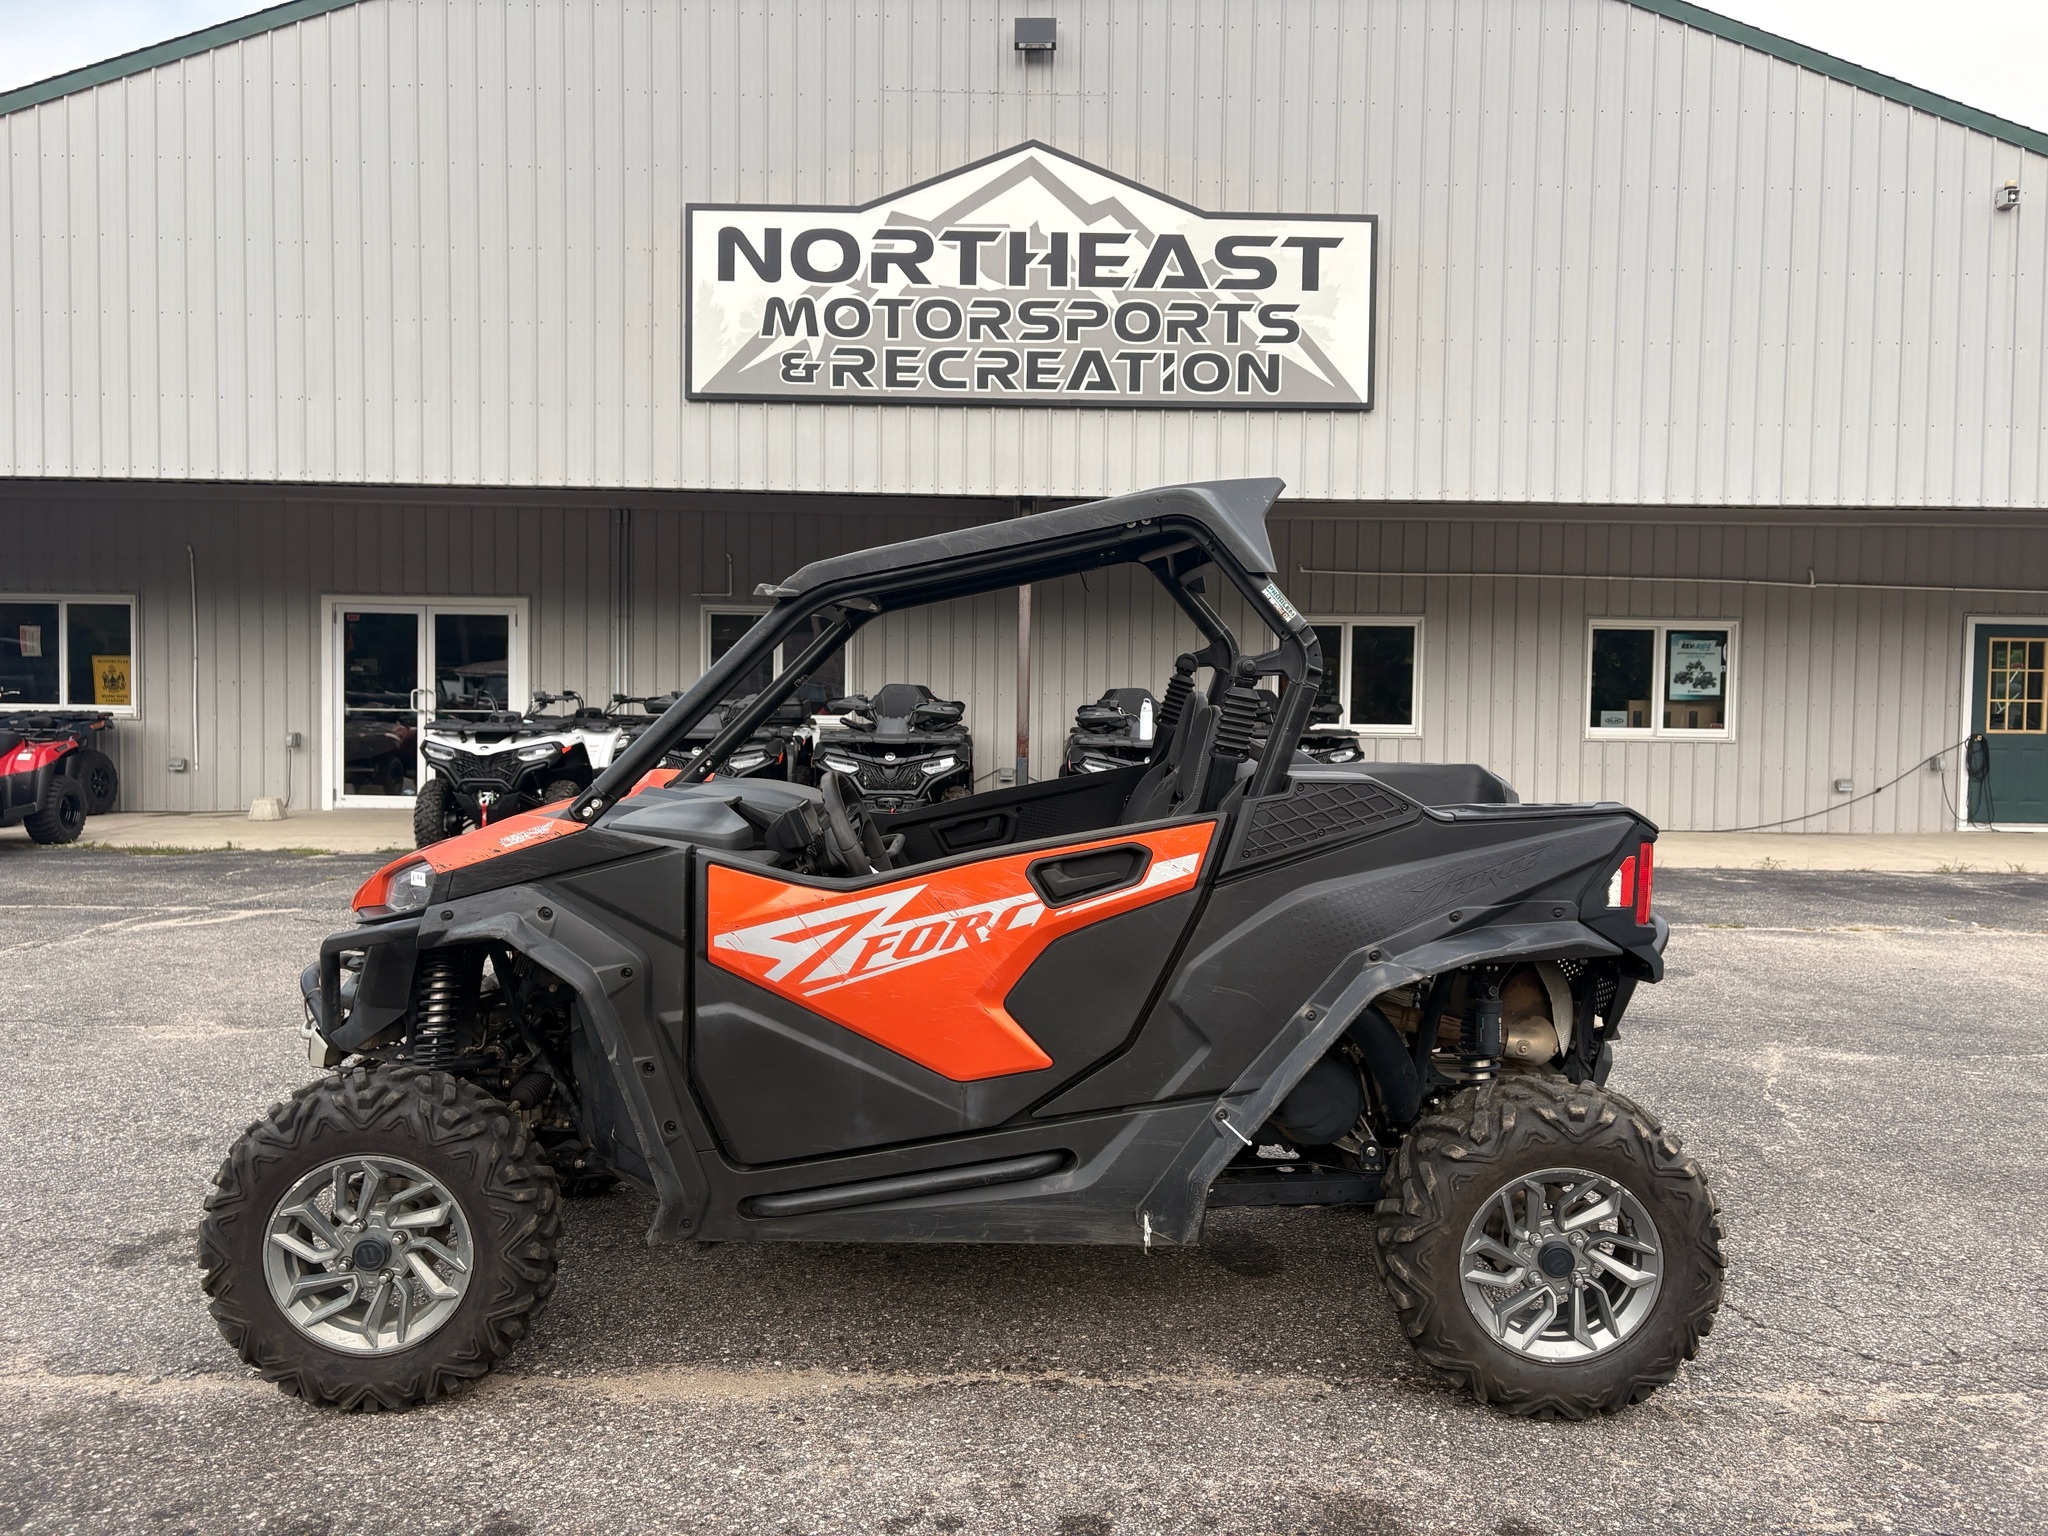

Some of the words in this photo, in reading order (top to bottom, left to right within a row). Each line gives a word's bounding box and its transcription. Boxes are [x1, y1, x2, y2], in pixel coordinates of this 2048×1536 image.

[716, 225, 1344, 292] NORTHEAST
[761, 296, 1300, 345] MOTORSPORTS
[714, 883, 1046, 996] ZFORC
